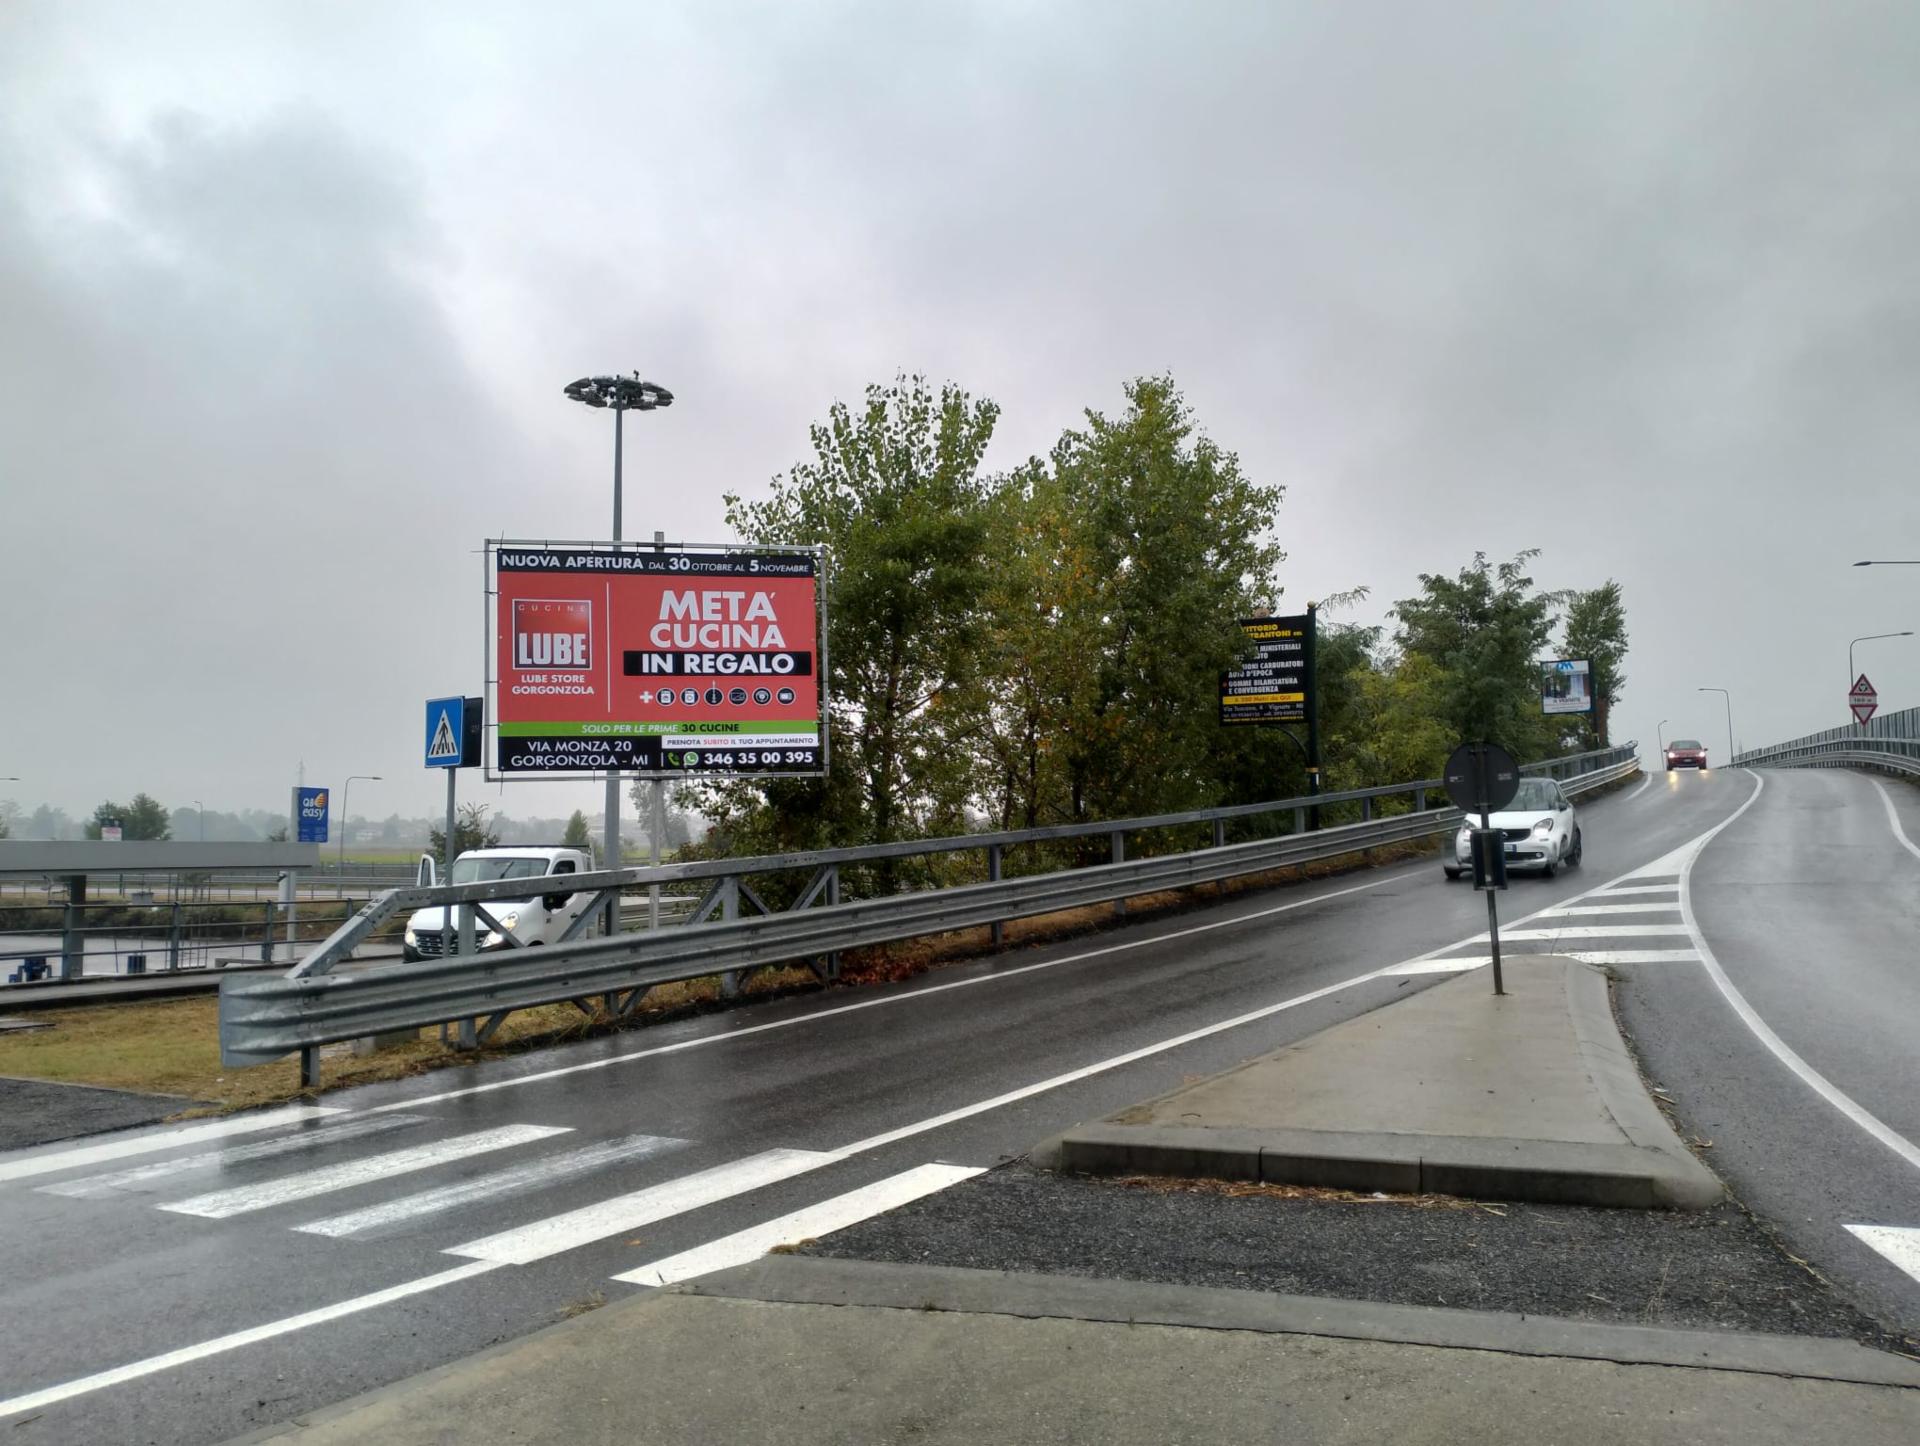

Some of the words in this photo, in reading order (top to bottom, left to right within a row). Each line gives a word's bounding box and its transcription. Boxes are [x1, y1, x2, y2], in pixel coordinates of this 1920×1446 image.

[502, 555, 561, 567] NUOVA
[565, 556, 643, 569] APERTURA
[649, 562, 665, 570] DAL
[669, 557, 690, 571] 30
[691, 562, 732, 571] OTTOBRE
[734, 563, 744, 571] AL
[749, 559, 759, 572] 5
[760, 564, 809, 573] NOVEMBRE
[519, 605, 586, 613] CUCINE
[1241, 624, 1278, 632] VITTORIO
[650, 623, 786, 649] CUCINA
[519, 632, 586, 665] LUBE
[642, 653, 673, 674] IN
[684, 653, 795, 674] REGALO
[521, 675, 547, 683] LUBE
[551, 675, 585, 684] STORE
[512, 686, 594, 695] GORGONZOLA
[581, 724, 610, 734] SOLO
[613, 724, 633, 733] PER
[634, 724, 647, 733] LE
[648, 724, 678, 733] PRIME
[682, 723, 696, 732] 30
[699, 723, 740, 732] CUCINE
[527, 741, 551, 752] VIA
[555, 741, 610, 752] MONZA
[614, 740, 632, 752] 20
[755, 737, 814, 745] APPUNTAMENTO
[511, 754, 618, 767] GORGONZOLA
[631, 754, 648, 766] MI
[704, 752, 733, 765] 346
[737, 752, 756, 764] 35
[761, 752, 780, 763] 00
[785, 751, 813, 763] 395
[302, 808, 326, 820] easy
